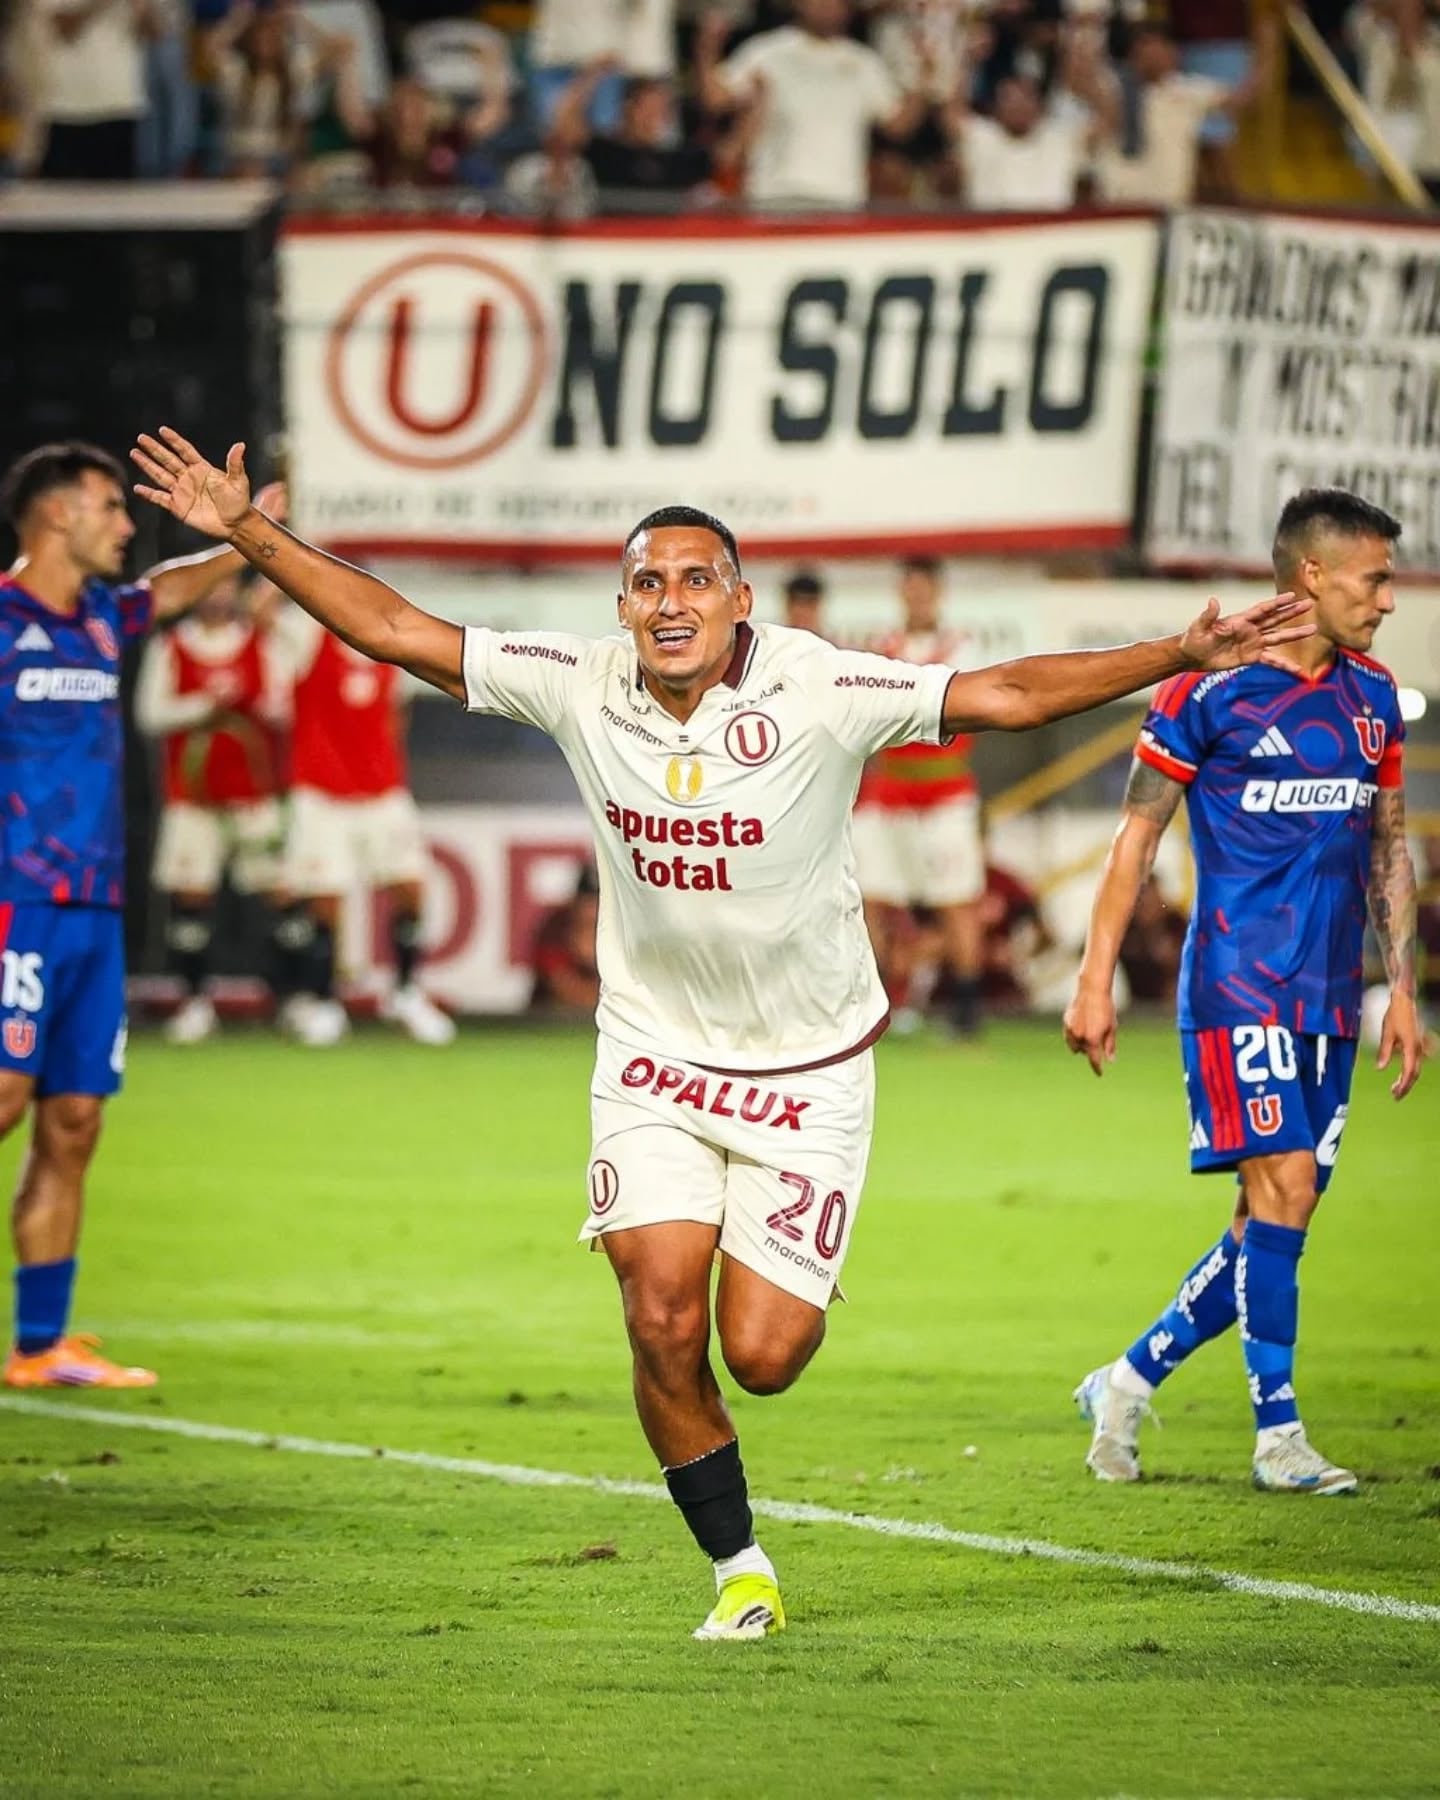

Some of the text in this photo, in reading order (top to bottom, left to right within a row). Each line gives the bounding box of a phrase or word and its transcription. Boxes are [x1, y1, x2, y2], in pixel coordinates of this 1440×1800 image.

[386, 265, 1110, 448] U NO SOLO
[518, 644, 579, 668] MOVISUN
[854, 674, 916, 691] MOVISUN
[600, 704, 664, 748] marathon
[735, 720, 769, 760] U
[1352, 716, 1386, 766] U
[605, 799, 765, 848] apuesta
[632, 847, 733, 892] total
[2, 949, 44, 1012] 15
[1233, 1025, 1297, 1083] 20
[620, 1056, 812, 1131] OPALUX
[1246, 1093, 1283, 1137] U
[765, 1170, 847, 1260] 20
[764, 1235, 831, 1282] marathon
